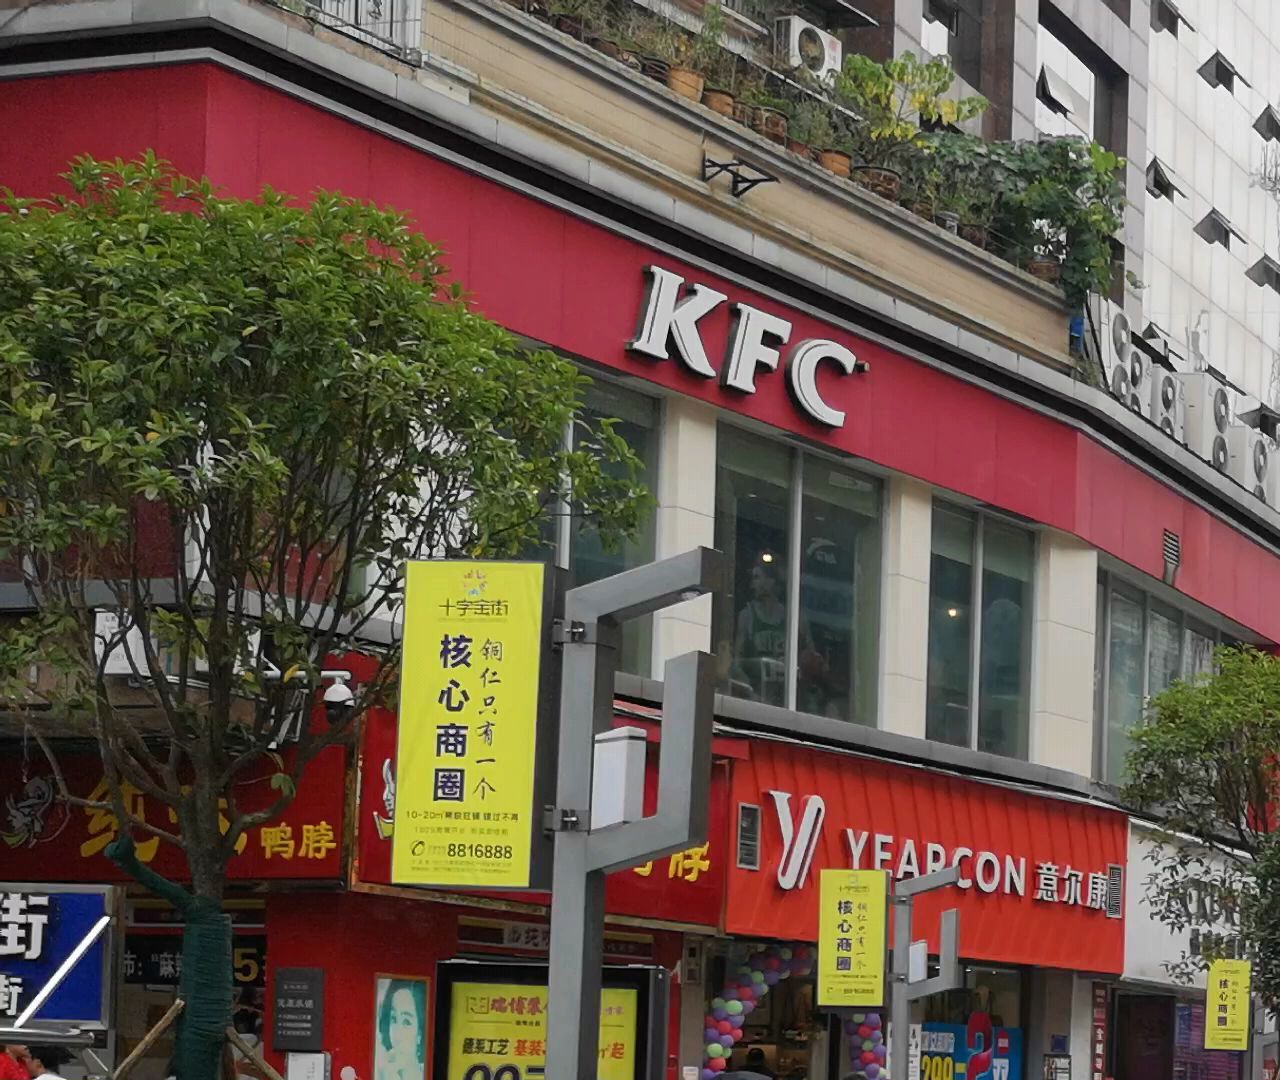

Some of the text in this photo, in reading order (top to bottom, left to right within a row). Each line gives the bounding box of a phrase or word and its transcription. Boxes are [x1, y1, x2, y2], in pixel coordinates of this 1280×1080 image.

[630, 266, 858, 428] KFC
[439, 599, 508, 616] 十字金街
[435, 634, 473, 802] 核心商圈
[260, 821, 337, 860] 鸭脖
[447, 843, 513, 859] 8816888
[846, 828, 1108, 910] YEARCON 意尔康
